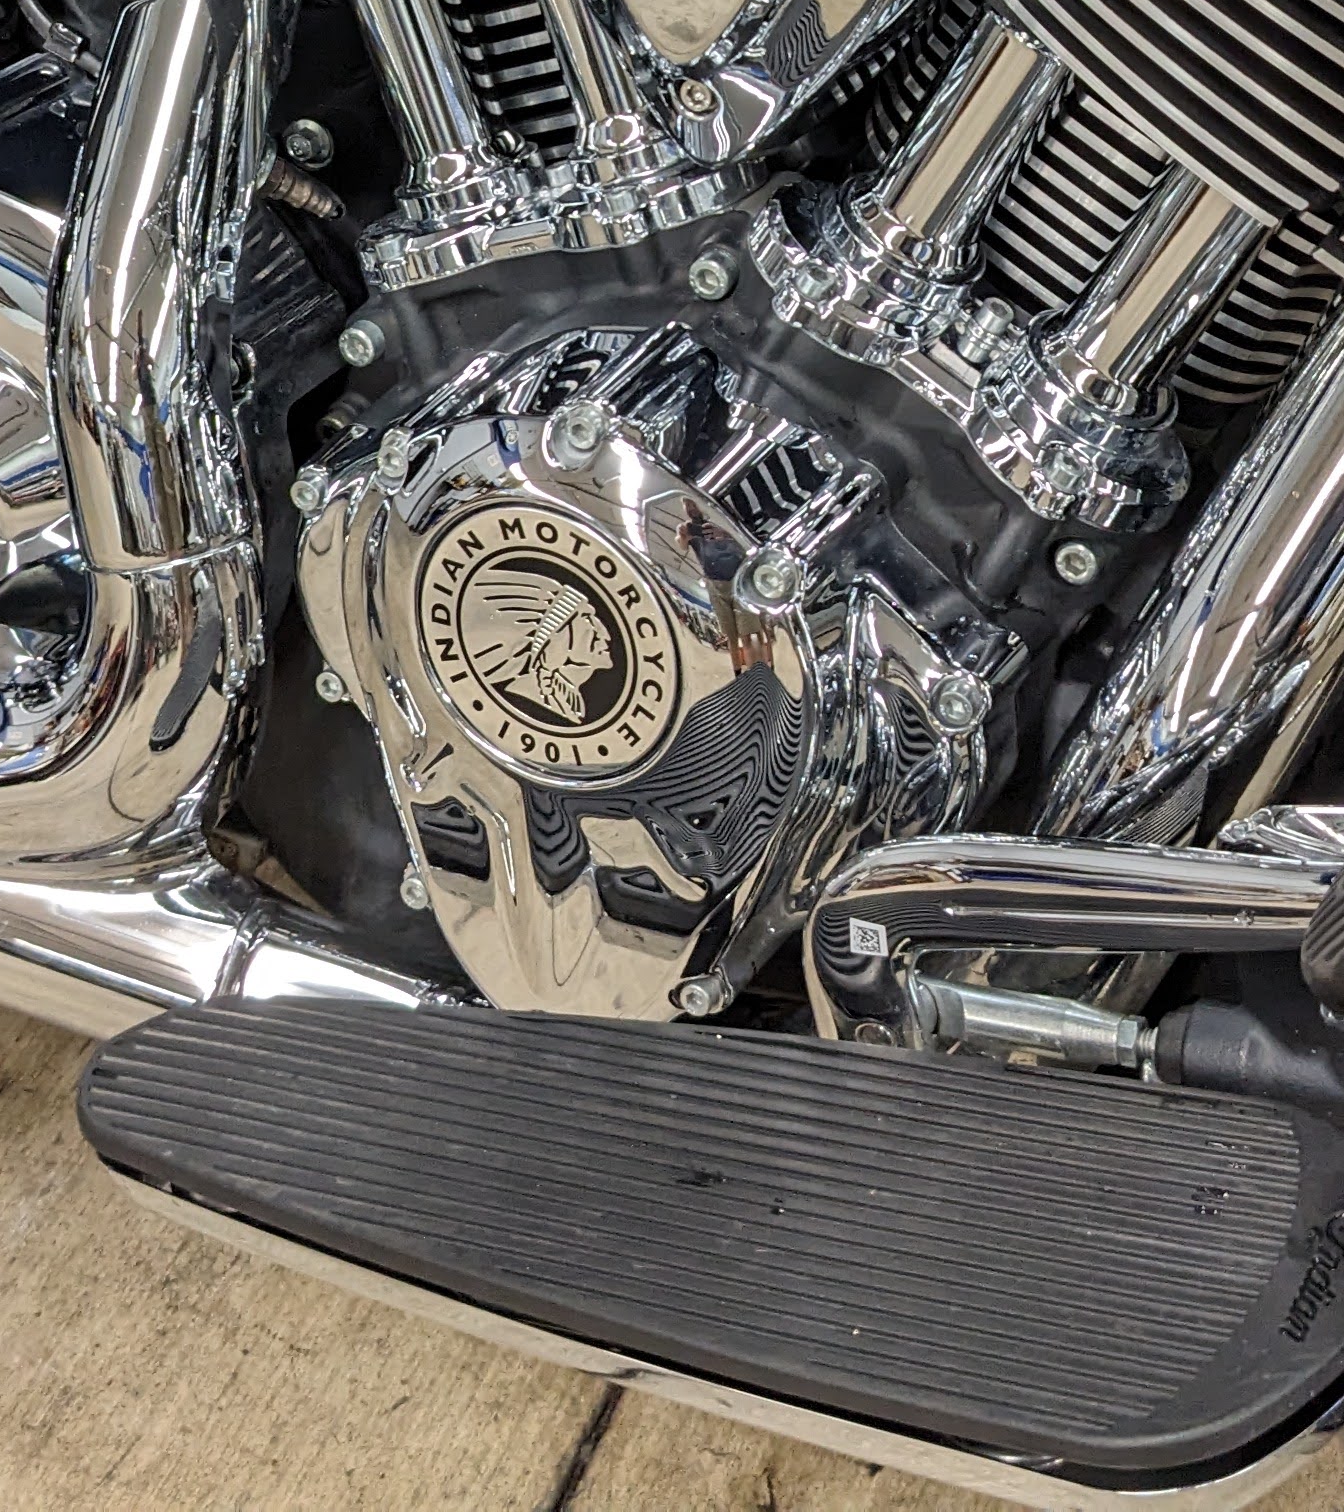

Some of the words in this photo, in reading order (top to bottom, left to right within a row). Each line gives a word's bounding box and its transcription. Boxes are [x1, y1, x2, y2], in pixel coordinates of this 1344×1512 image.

[431, 530, 485, 683] INDIAN
[498, 517, 665, 747] MOTORCYCLE
[497, 721, 582, 766] 1901
